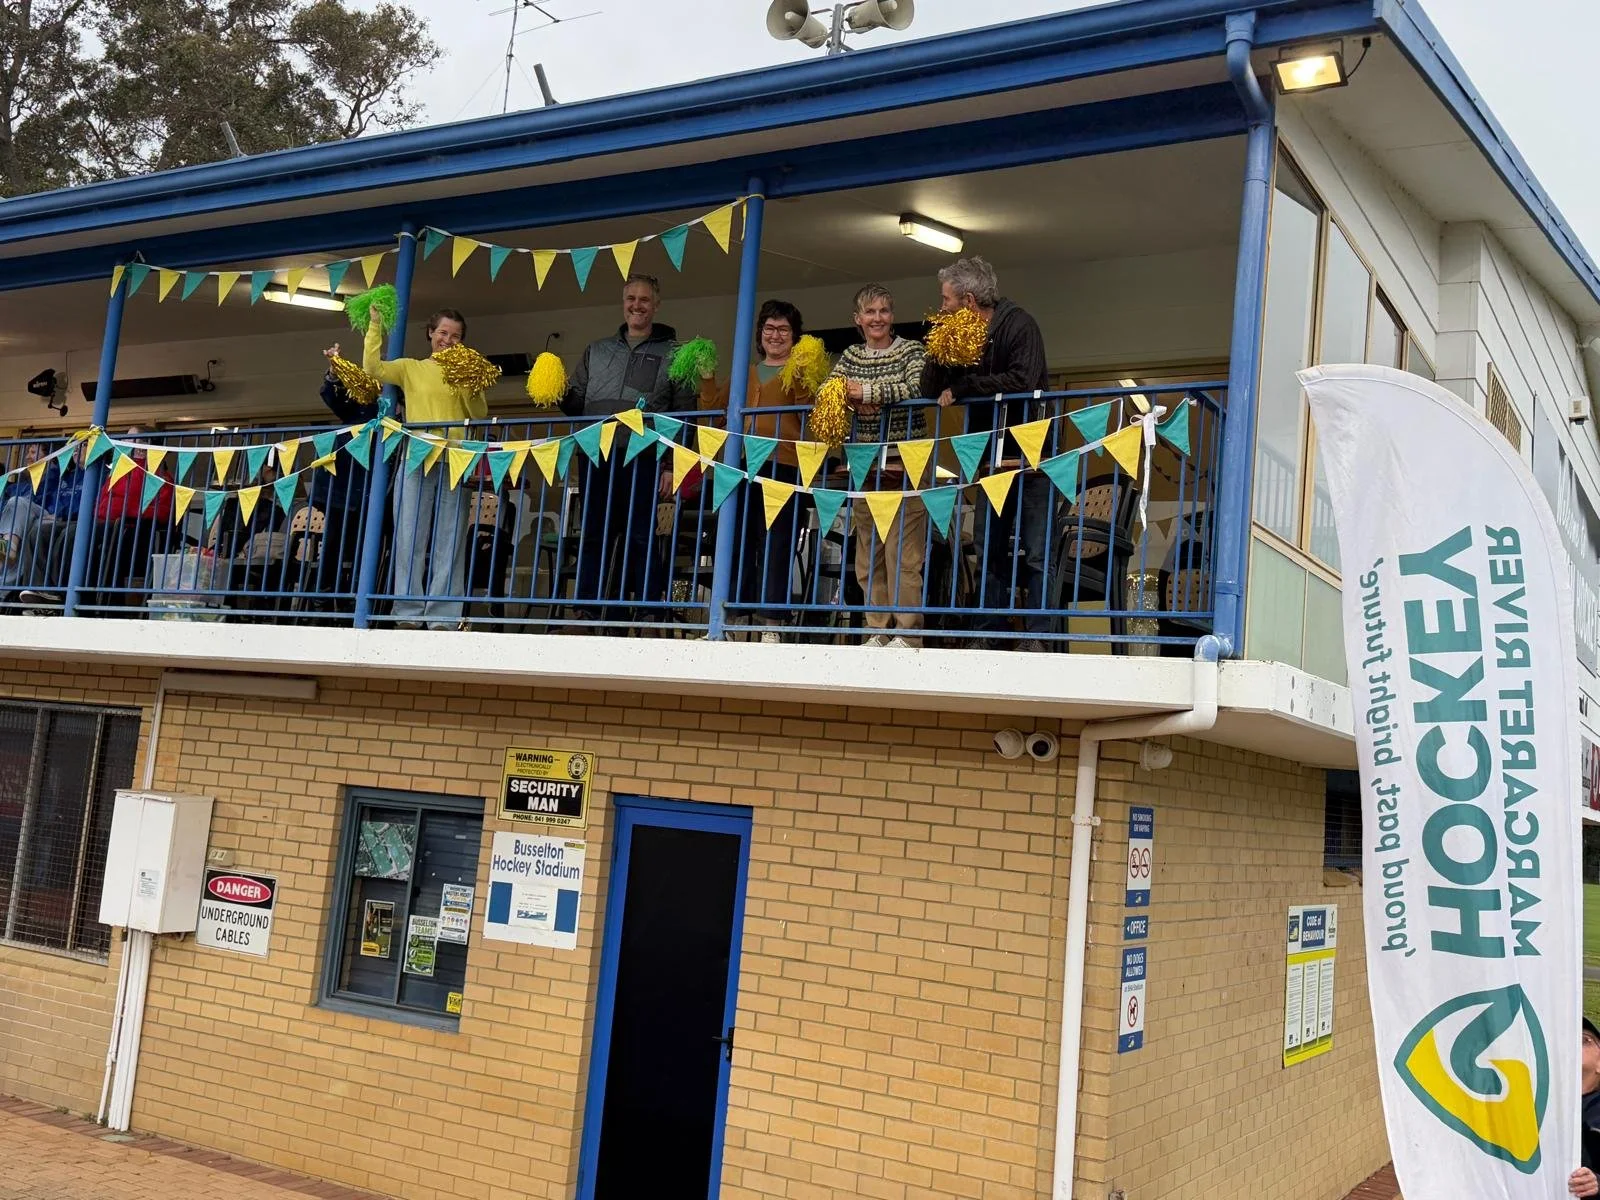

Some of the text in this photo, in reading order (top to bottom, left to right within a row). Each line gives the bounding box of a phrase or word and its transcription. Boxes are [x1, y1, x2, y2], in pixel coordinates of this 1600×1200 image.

[515, 753, 554, 764] WARNING
[515, 762, 552, 770] ELECTRONICALLY
[516, 768, 542, 776] PROTECTED
[510, 779, 580, 799] SECURITY
[527, 796, 559, 813] MAN
[512, 813, 534, 822] PHONE:
[514, 839, 564, 860] Busselton
[492, 854, 580, 880] Hockey Stadium
[216, 880, 261, 899] DANGER
[201, 905, 269, 930] UNDERGROUND
[1306, 915, 1317, 927] CODE
[1130, 920, 1146, 934] OFFICE
[215, 927, 251, 946] CABLES
[1302, 929, 1325, 942] BEHAVIOUR
[1126, 952, 1144, 965] NO DOGS
[1125, 965, 1144, 978] ALLOWED
